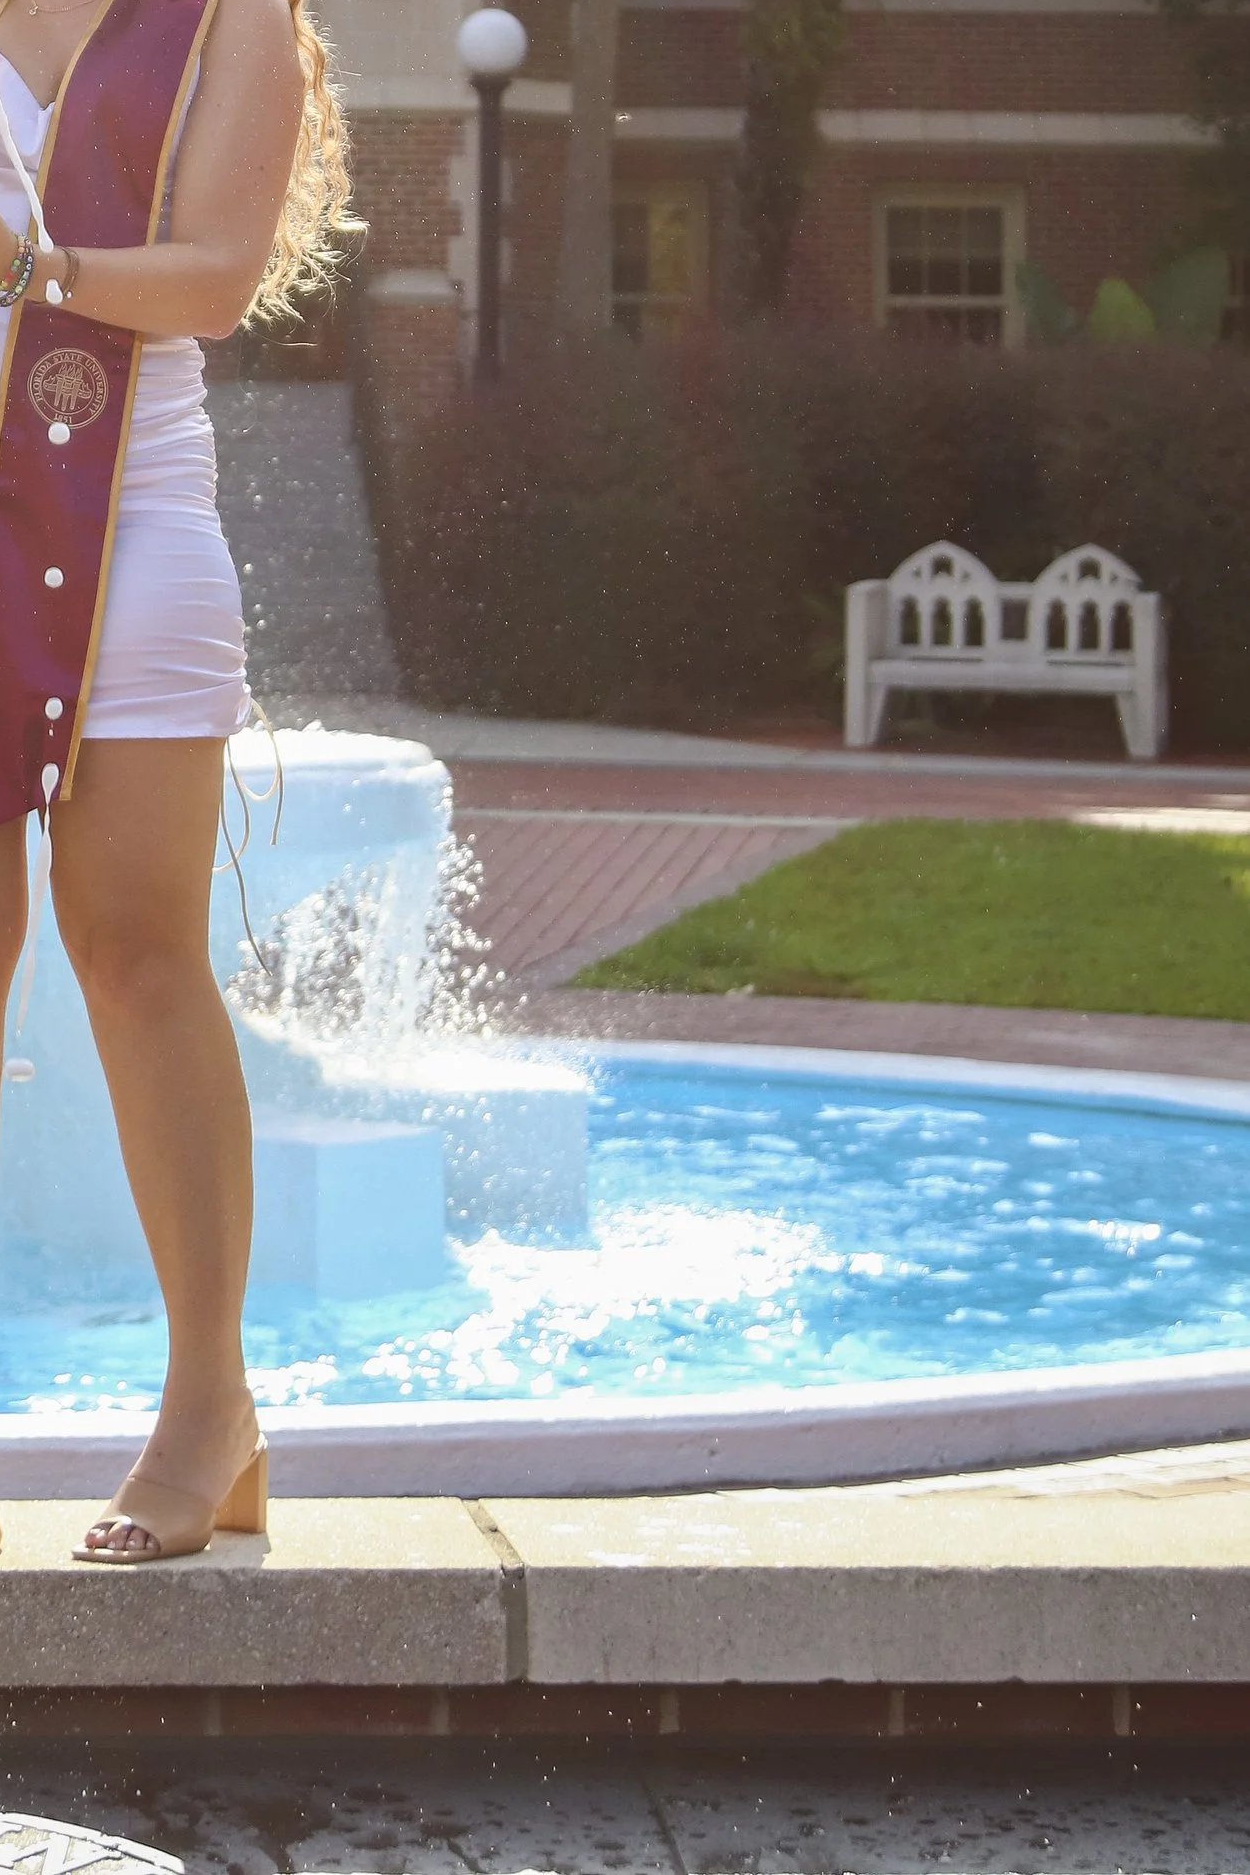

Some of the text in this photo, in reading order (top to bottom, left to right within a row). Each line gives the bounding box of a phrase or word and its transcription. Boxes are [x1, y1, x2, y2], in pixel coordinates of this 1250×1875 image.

[33, 353, 104, 415] FLORIDA STATE UNIVERSITY
[53, 413, 73, 424] 1851
